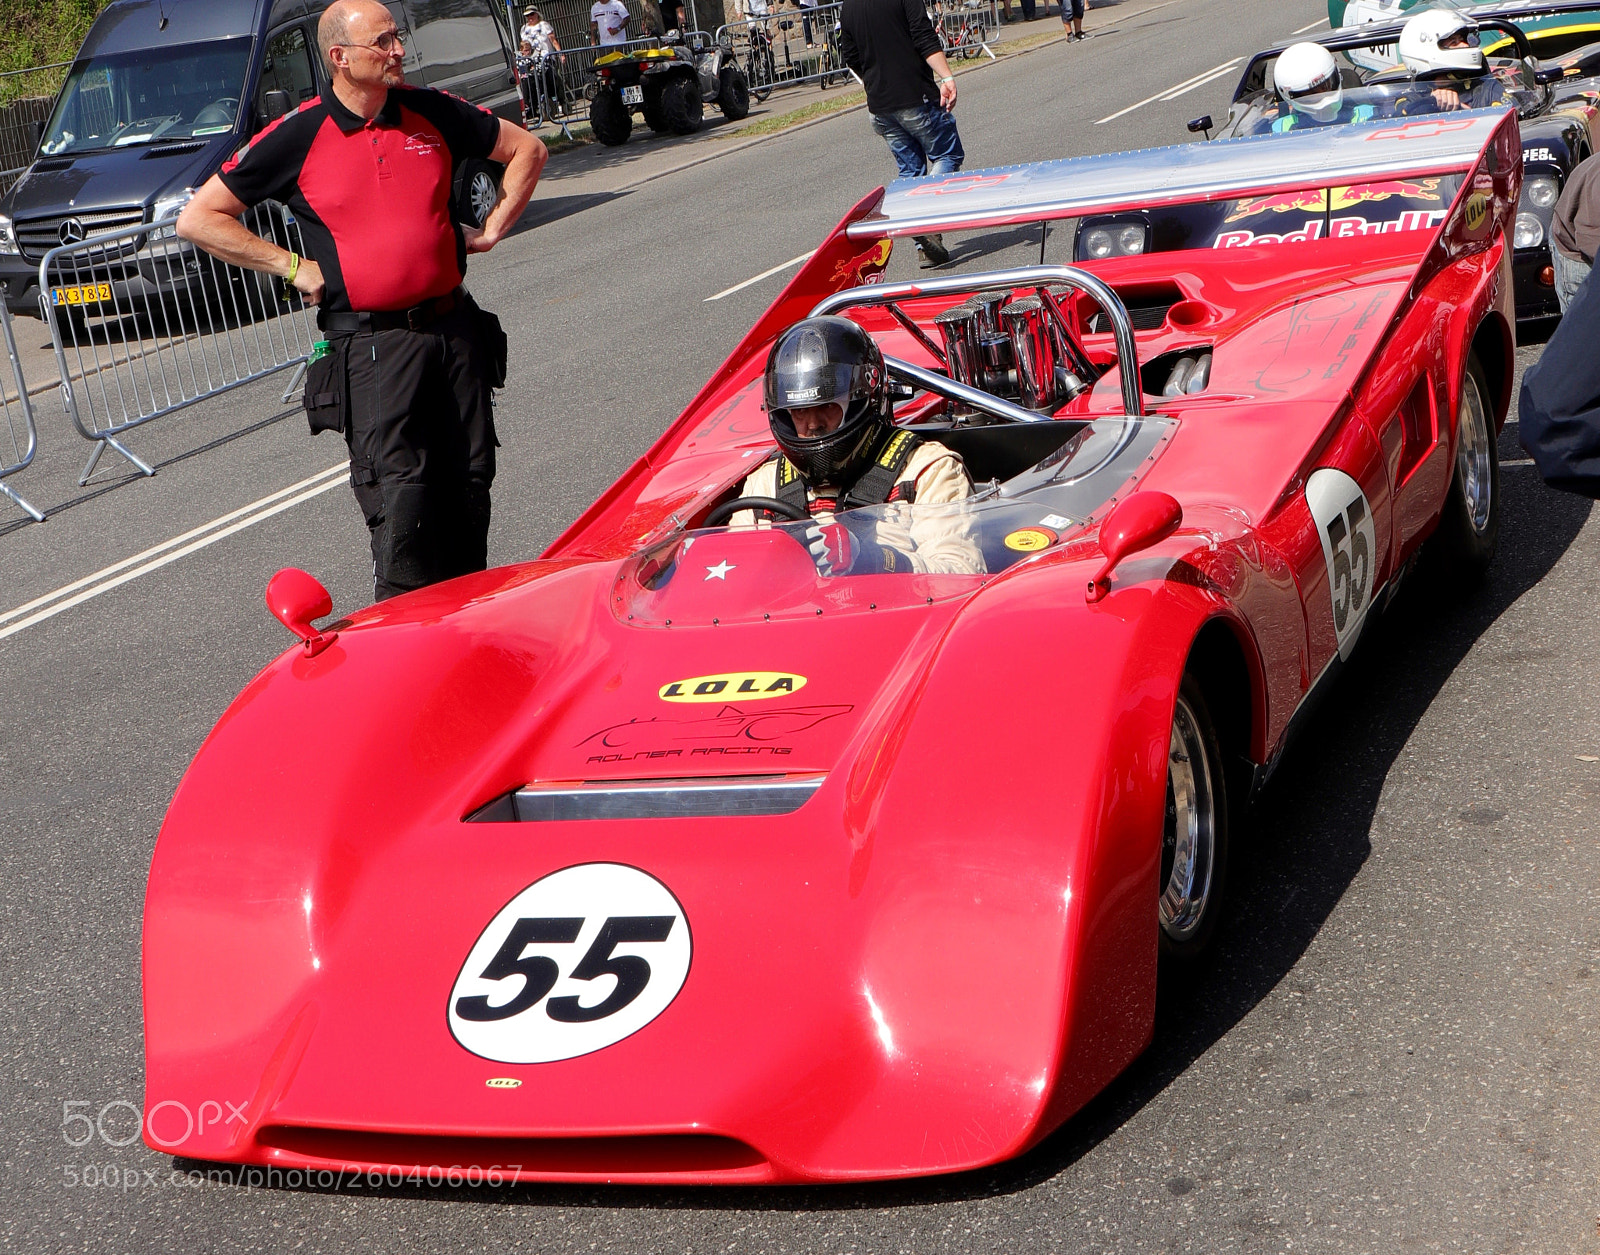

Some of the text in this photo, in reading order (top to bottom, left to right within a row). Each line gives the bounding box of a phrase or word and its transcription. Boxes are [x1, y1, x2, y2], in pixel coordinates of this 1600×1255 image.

[1327, 494, 1369, 633] 55
[663, 677, 793, 698] LOLA
[690, 746, 793, 756] RACING
[455, 915, 677, 1023] 55
